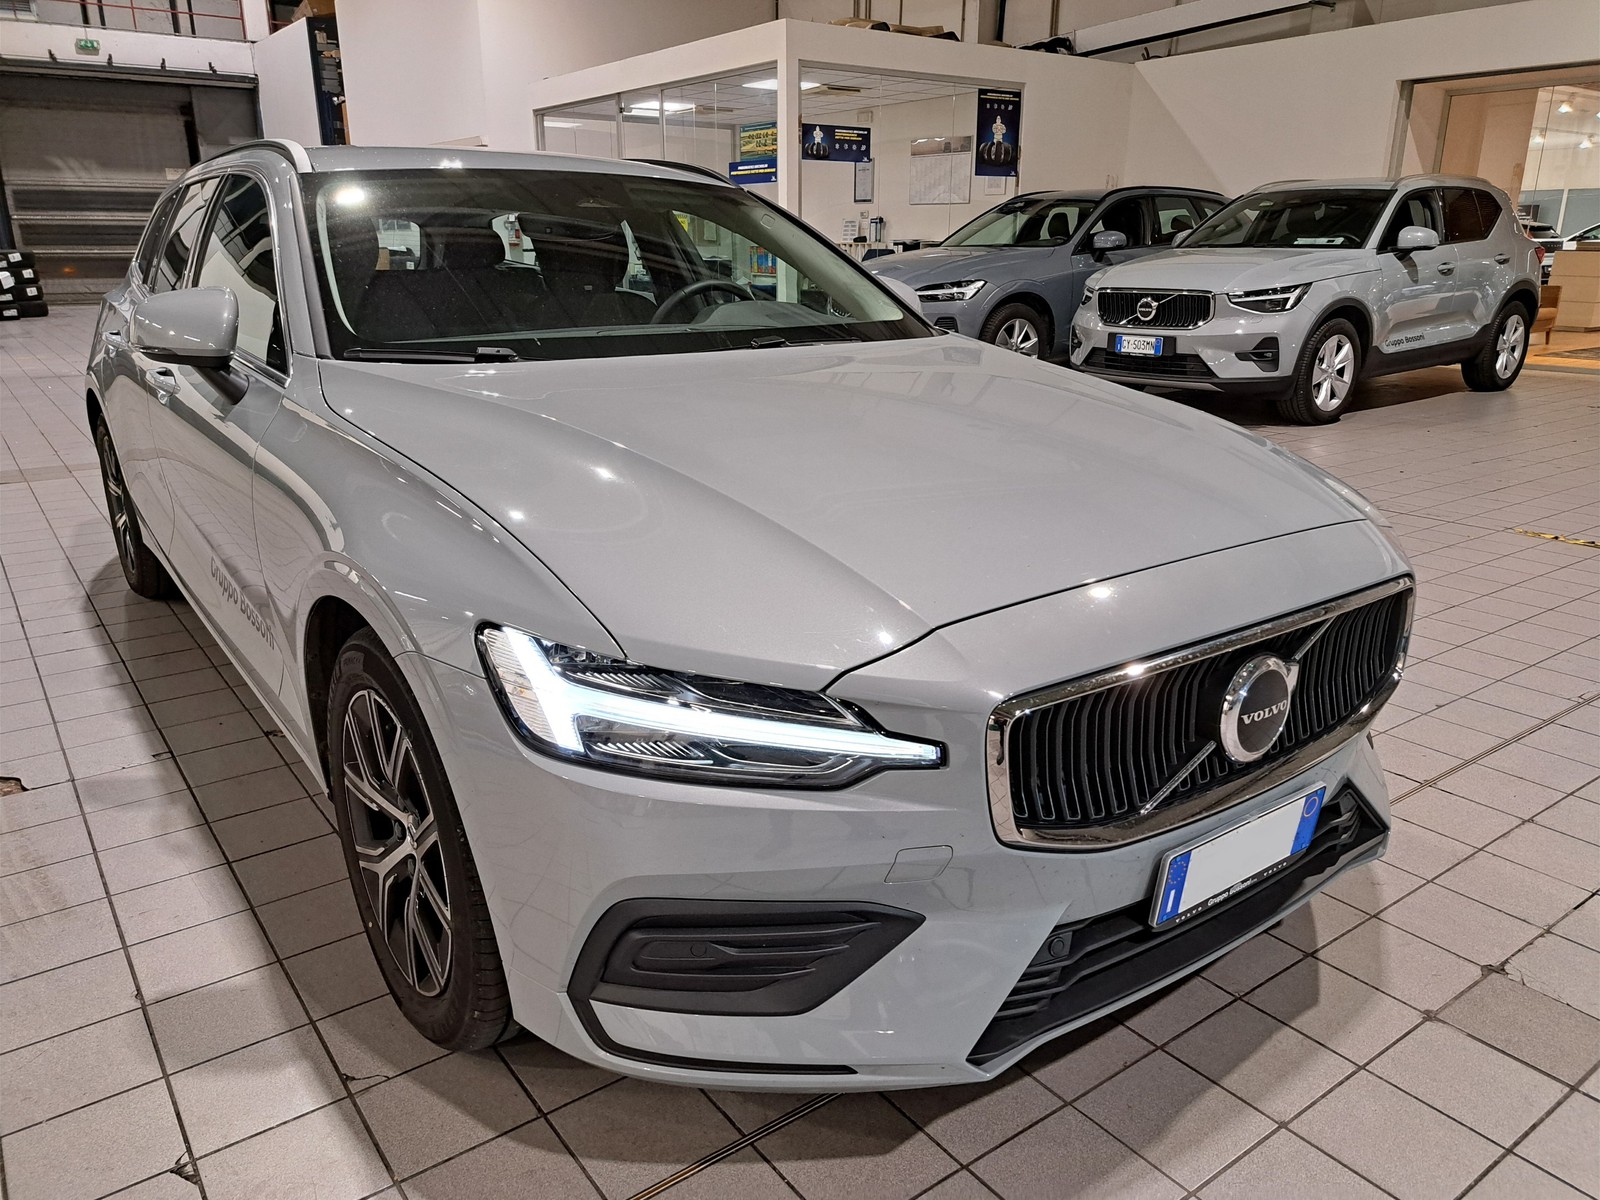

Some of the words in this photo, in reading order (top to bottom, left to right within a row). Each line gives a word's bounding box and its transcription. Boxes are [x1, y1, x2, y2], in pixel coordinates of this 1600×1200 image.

[1384, 338, 1405, 348] Gruppo
[1404, 332, 1426, 344] Bossoni
[210, 556, 239, 605] Gruppo
[1240, 699, 1288, 725] VOLVO
[1207, 891, 1229, 906] Gruppo
